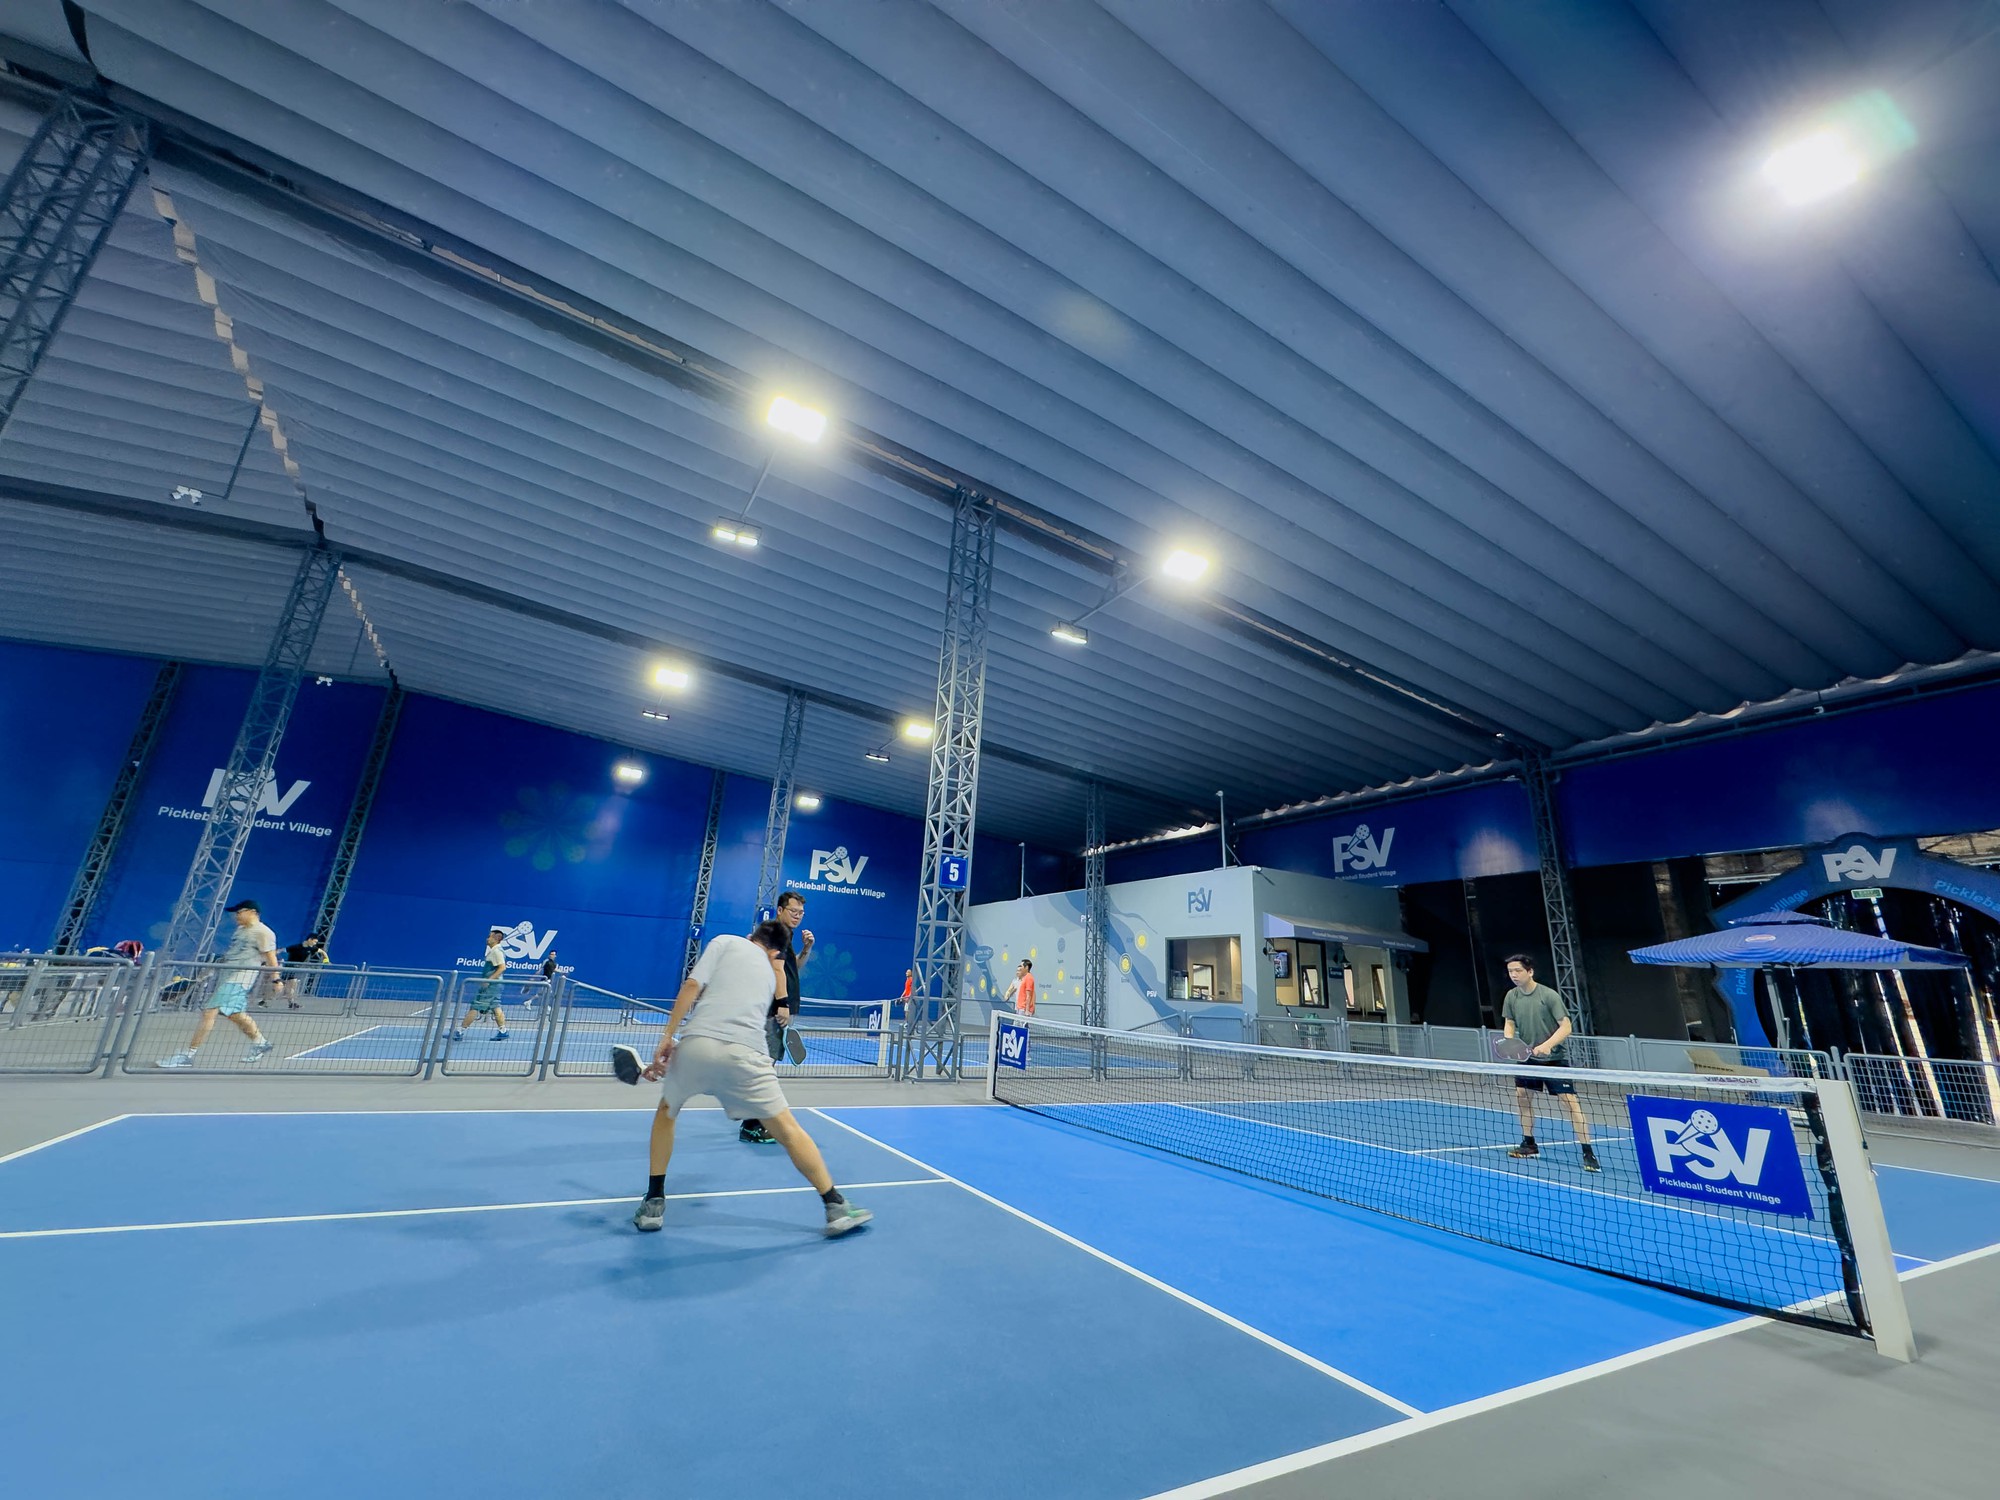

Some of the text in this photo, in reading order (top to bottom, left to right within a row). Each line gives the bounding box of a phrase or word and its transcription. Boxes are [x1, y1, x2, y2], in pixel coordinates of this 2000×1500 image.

[157, 805, 333, 837] Pickleba Sdent Village
[1332, 824, 1395, 873] PSV
[808, 846, 869, 885] PSV
[949, 862, 959, 882] 5
[1822, 844, 1897, 883] PSV
[786, 879, 886, 899] Pickleball Student Village
[1188, 887, 1212, 914] PSV
[763, 910, 770, 921] 6
[694, 928, 700, 936] 7
[456, 957, 493, 968] Pickle
[1001, 1029, 1025, 1059] PSV
[1647, 1109, 1771, 1186] PSV
[1659, 1176, 1781, 1205] Pickleball Student Village
